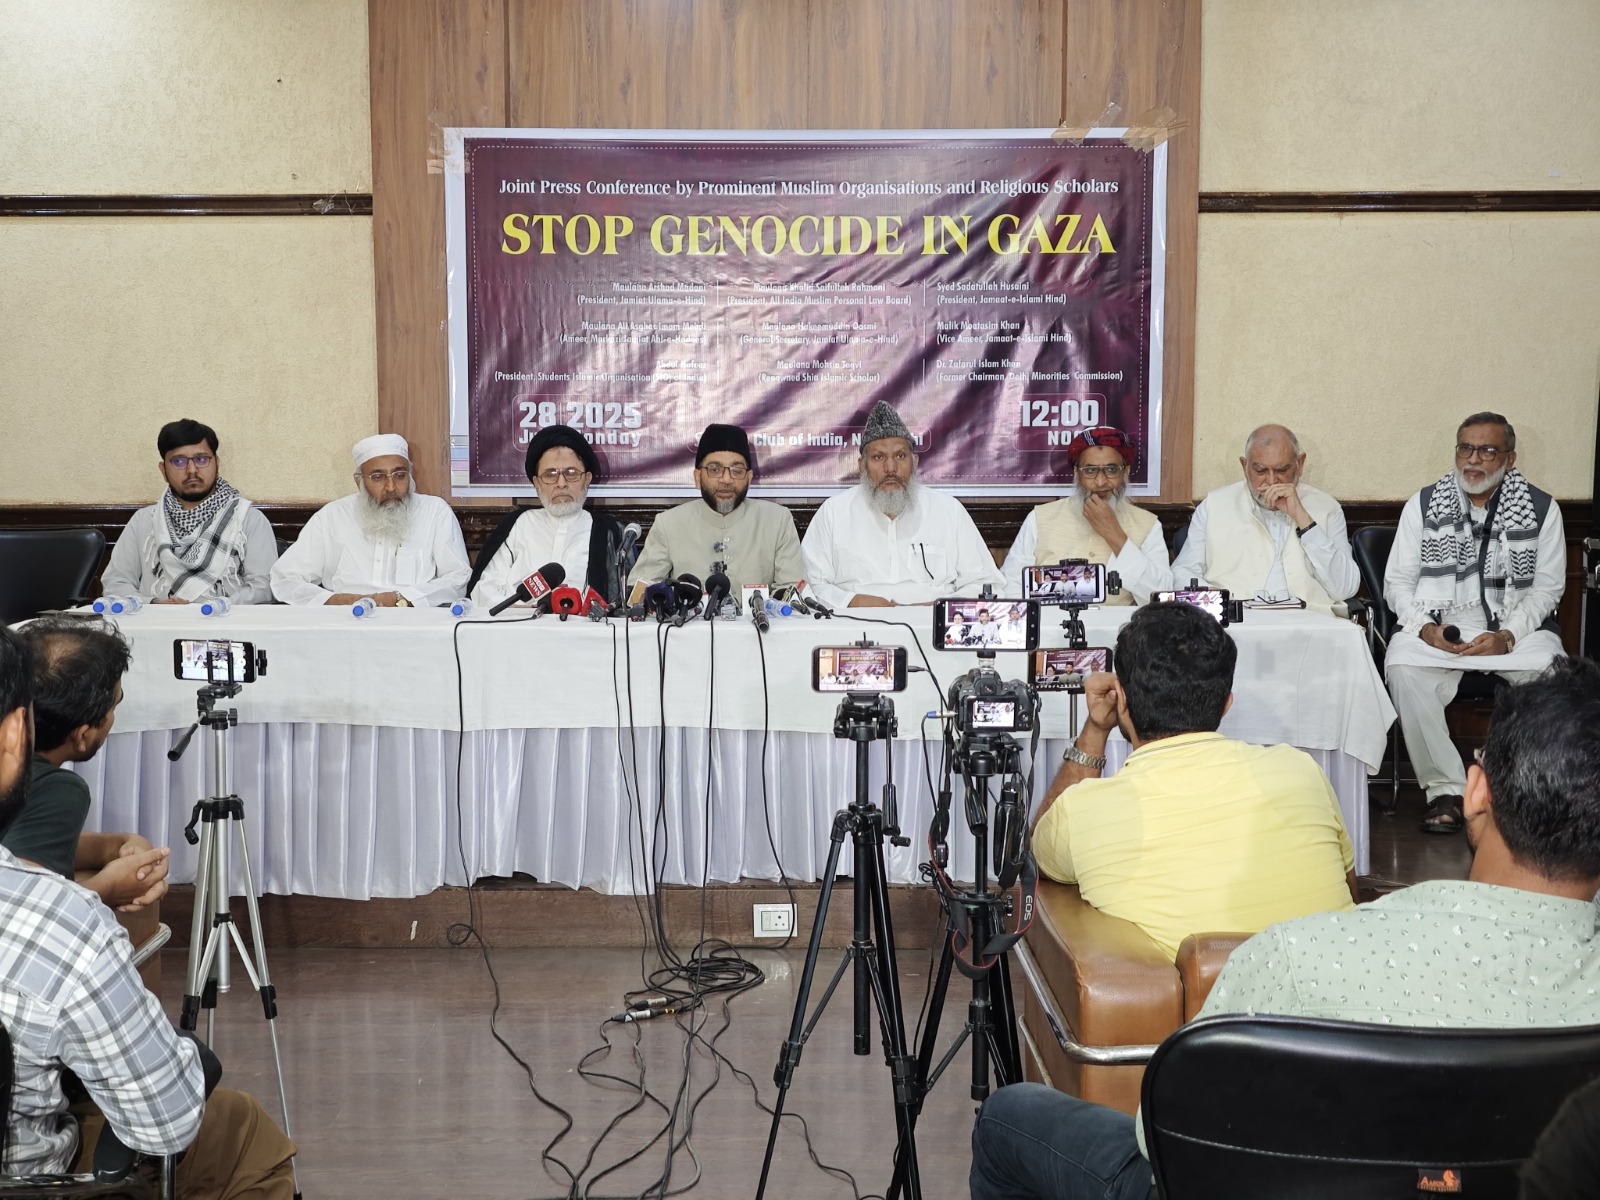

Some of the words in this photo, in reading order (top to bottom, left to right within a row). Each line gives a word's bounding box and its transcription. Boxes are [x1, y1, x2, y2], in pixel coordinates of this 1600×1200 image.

[499, 179, 536, 194] Joint
[540, 180, 581, 194] Press
[586, 180, 670, 195] Conference
[676, 180, 695, 197] by
[698, 180, 776, 195] Prominent
[781, 181, 834, 195] Muslim
[839, 181, 942, 198] Organisations
[947, 179, 975, 194] and
[980, 179, 1049, 197] Religious
[1054, 179, 1119, 193] Scholars
[502, 213, 635, 255] STOP
[650, 214, 905, 256] GENOCIDE
[921, 214, 972, 255] IN
[988, 213, 1117, 255] GAZA
[612, 282, 646, 291] Maulana
[815, 282, 850, 292] Saifullah
[852, 282, 886, 292] Rahmani
[937, 282, 955, 293] Syed
[956, 281, 998, 291] Sadatullah
[1000, 281, 1030, 291] Husaini
[577, 294, 618, 306] (President,
[620, 295, 646, 304] Jamiat
[648, 294, 706, 306] Ulama-e-Hind)
[770, 295, 780, 305] All
[783, 295, 802, 305] India
[804, 295, 832, 305] Muslim
[834, 294, 867, 305] Personal
[869, 295, 884, 305] Law
[886, 294, 912, 306] Board)
[937, 294, 978, 306] (President,
[980, 294, 1043, 304] Jamaat-e-Islami
[1045, 293, 1067, 305] Hind)
[581, 321, 615, 330] Maulana
[852, 321, 877, 330] Qasmi
[937, 321, 959, 330] Malik
[961, 321, 998, 330] Moatasim
[1001, 320, 1020, 330] Khan
[560, 333, 588, 345] (Ameer,
[937, 333, 956, 345] (Vice
[957, 334, 982, 344] Ameer,
[985, 333, 1048, 344] Jamaat-e-Islami
[1050, 333, 1072, 344] Hind)
[812, 360, 839, 369] Mohsin
[841, 360, 862, 371] Taqvi
[936, 359, 946, 368] Dr.
[949, 360, 977, 368] Zafarul
[979, 359, 999, 368] Islam
[1001, 358, 1021, 368] Khan
[494, 371, 536, 382] (President,
[537, 371, 570, 381] Students
[601, 372, 651, 383] Organisation
[802, 372, 819, 382] Shia
[821, 372, 848, 382] Islamic
[849, 372, 880, 384] Scholar)
[936, 371, 966, 383] (Former
[1032, 371, 1070, 381] Minorities
[1074, 370, 1124, 382] Commission)
[518, 401, 557, 428] 28
[566, 401, 642, 428] 2025
[1020, 400, 1099, 427] 12:00
[577, 429, 642, 447] onday
[753, 432, 785, 447] Club
[788, 432, 804, 447] of
[807, 432, 847, 448] India,
[1024, 895, 1033, 921] EOS
